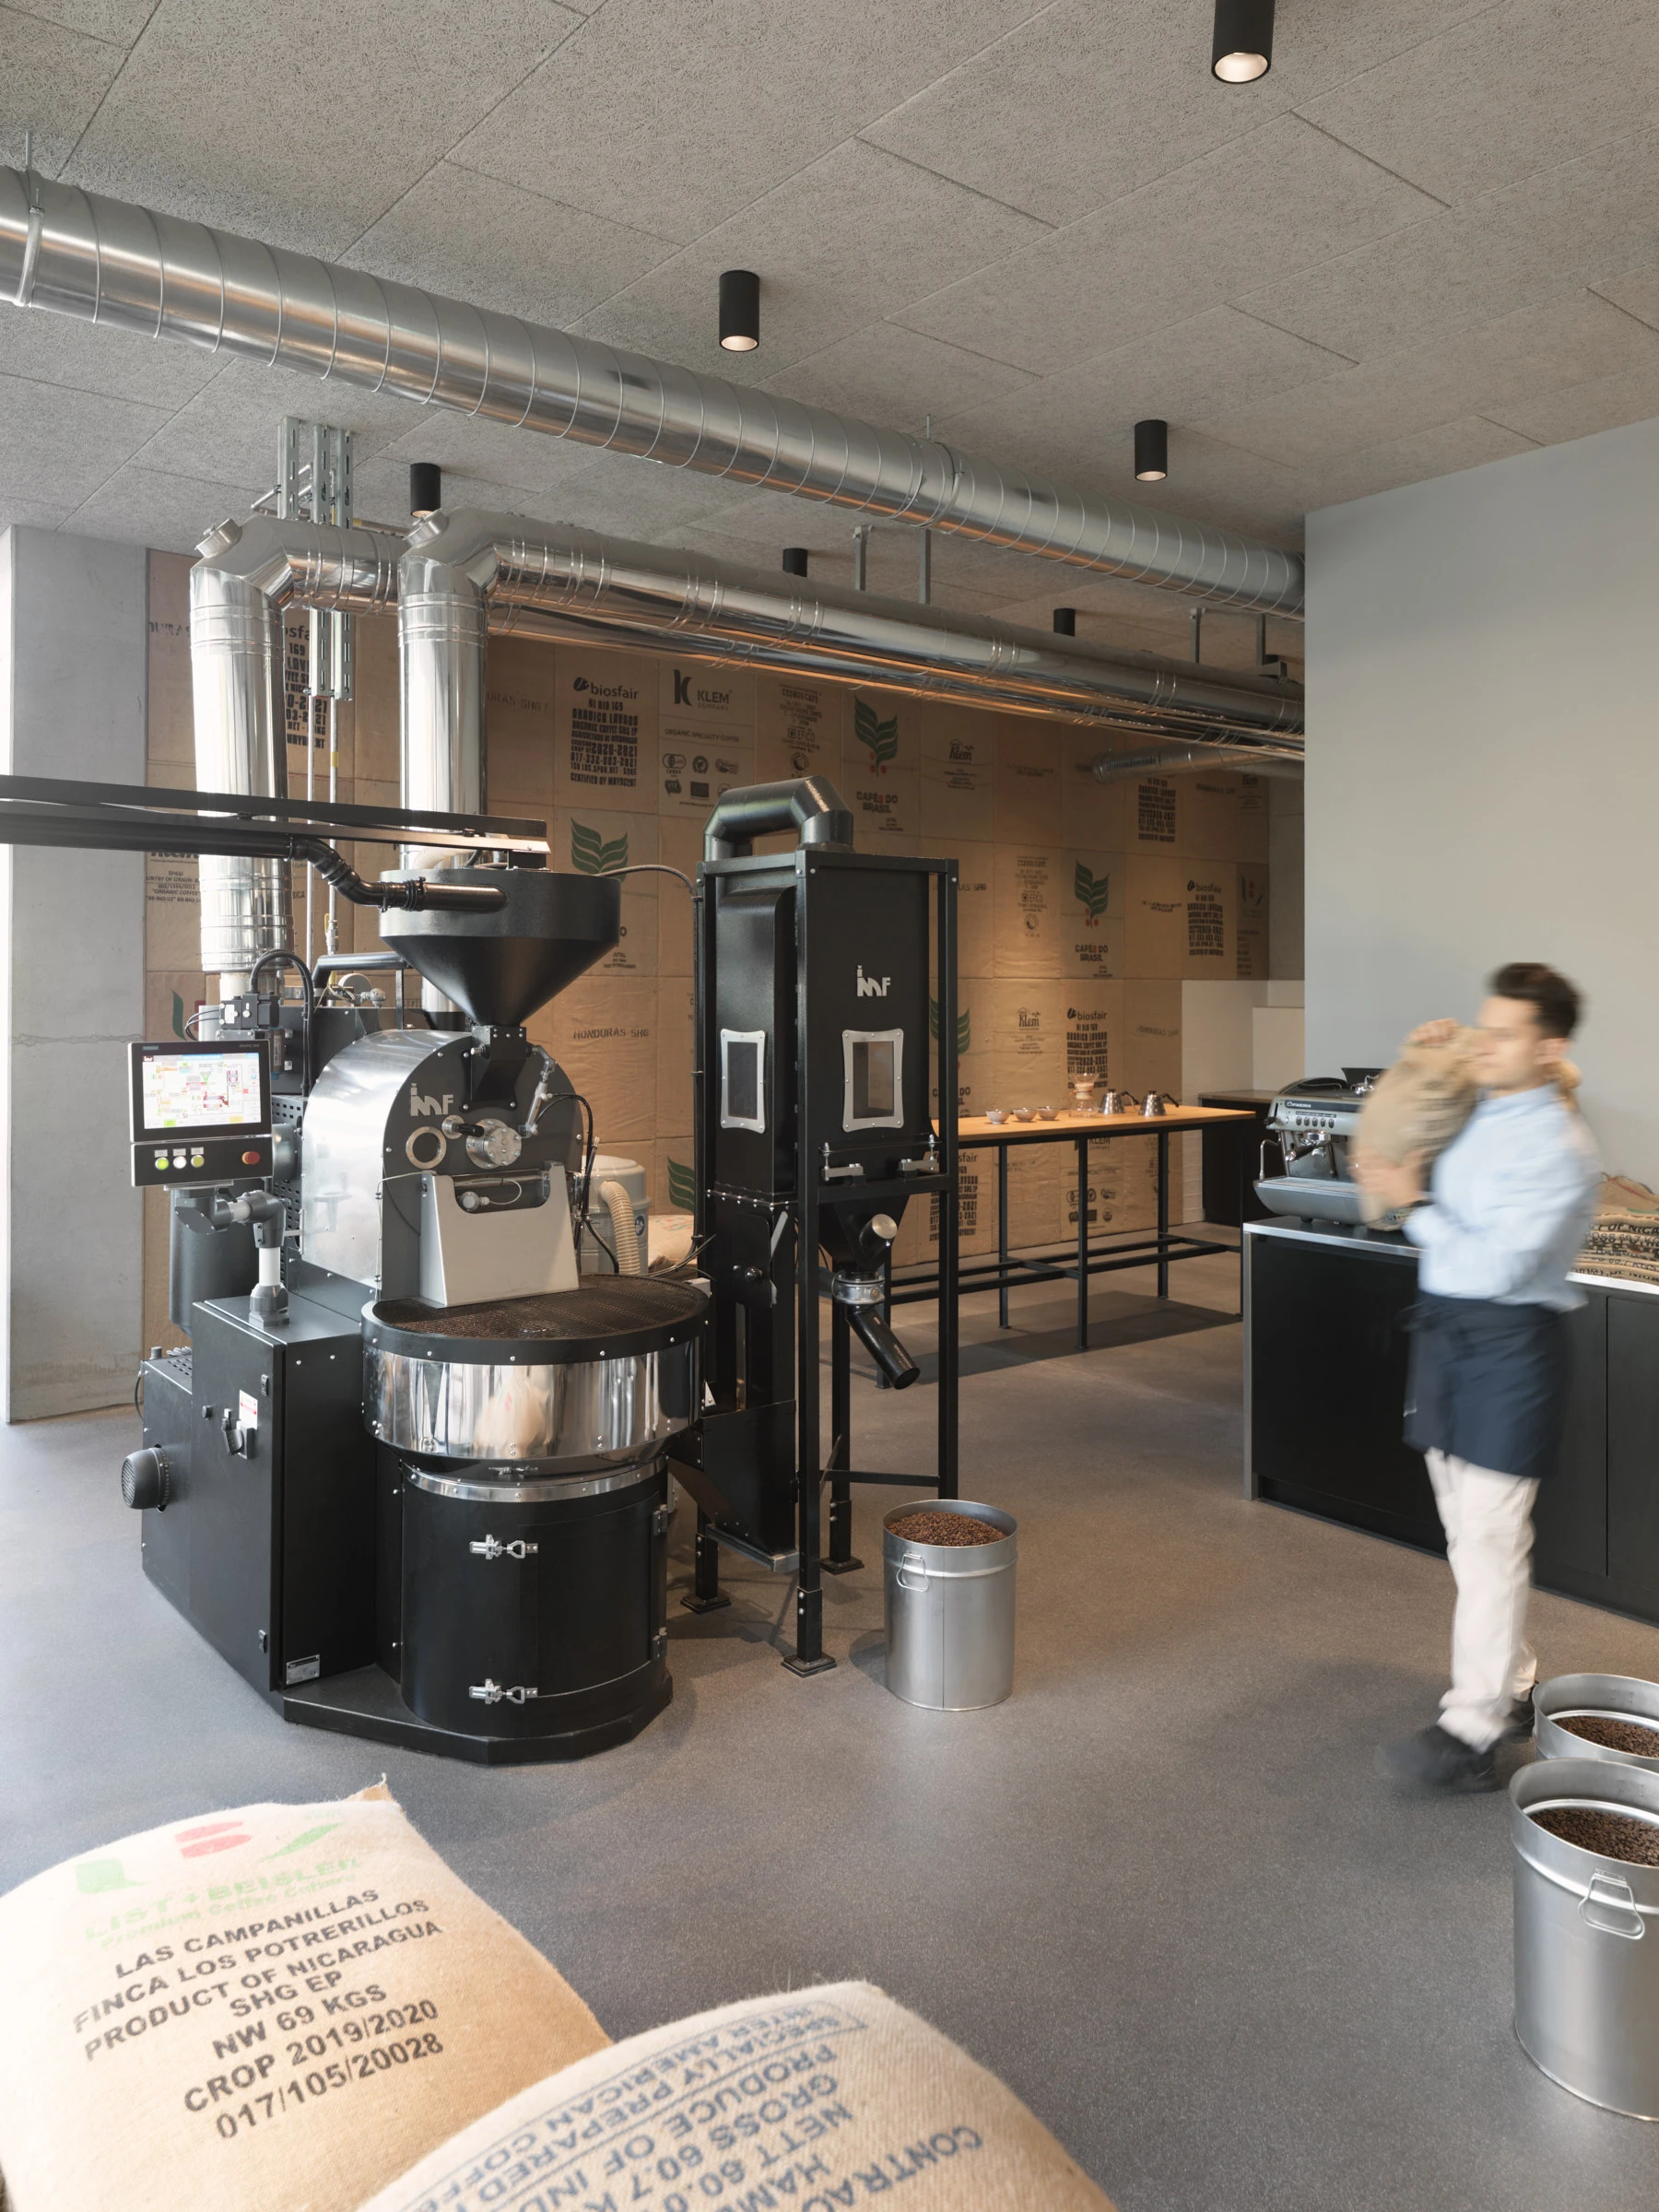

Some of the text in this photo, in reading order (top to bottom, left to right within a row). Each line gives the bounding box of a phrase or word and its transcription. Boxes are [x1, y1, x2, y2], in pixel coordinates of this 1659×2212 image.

[591, 682, 639, 700] biosfair
[863, 802, 892, 814] BRASIL
[573, 1028, 649, 1040] HONDURAS SHG
[1077, 1010, 1108, 1020] biosfair
[959, 1153, 977, 1162] sfair
[206, 1857, 362, 1901] BEISLER
[74, 1899, 430, 2033] FINCA LOS POTRERILLOS
[114, 1888, 381, 1979] LAS CAMPANILLAS
[84, 1918, 444, 2062] PRODUCT OF NICARAGUA
[211, 1983, 388, 2060] NW 69 KGS
[229, 1970, 344, 2019] SHG EP
[183, 1999, 440, 2113] CROP 2019/2020
[215, 2032, 444, 2140] 017/105/20028
[663, 2044, 838, 2139] PRODUCE
[477, 2080, 674, 2202] PREPARED
[709, 2074, 838, 2151] GROSS
[756, 2101, 853, 2169] NETT
[604, 2135, 655, 2177] OF
